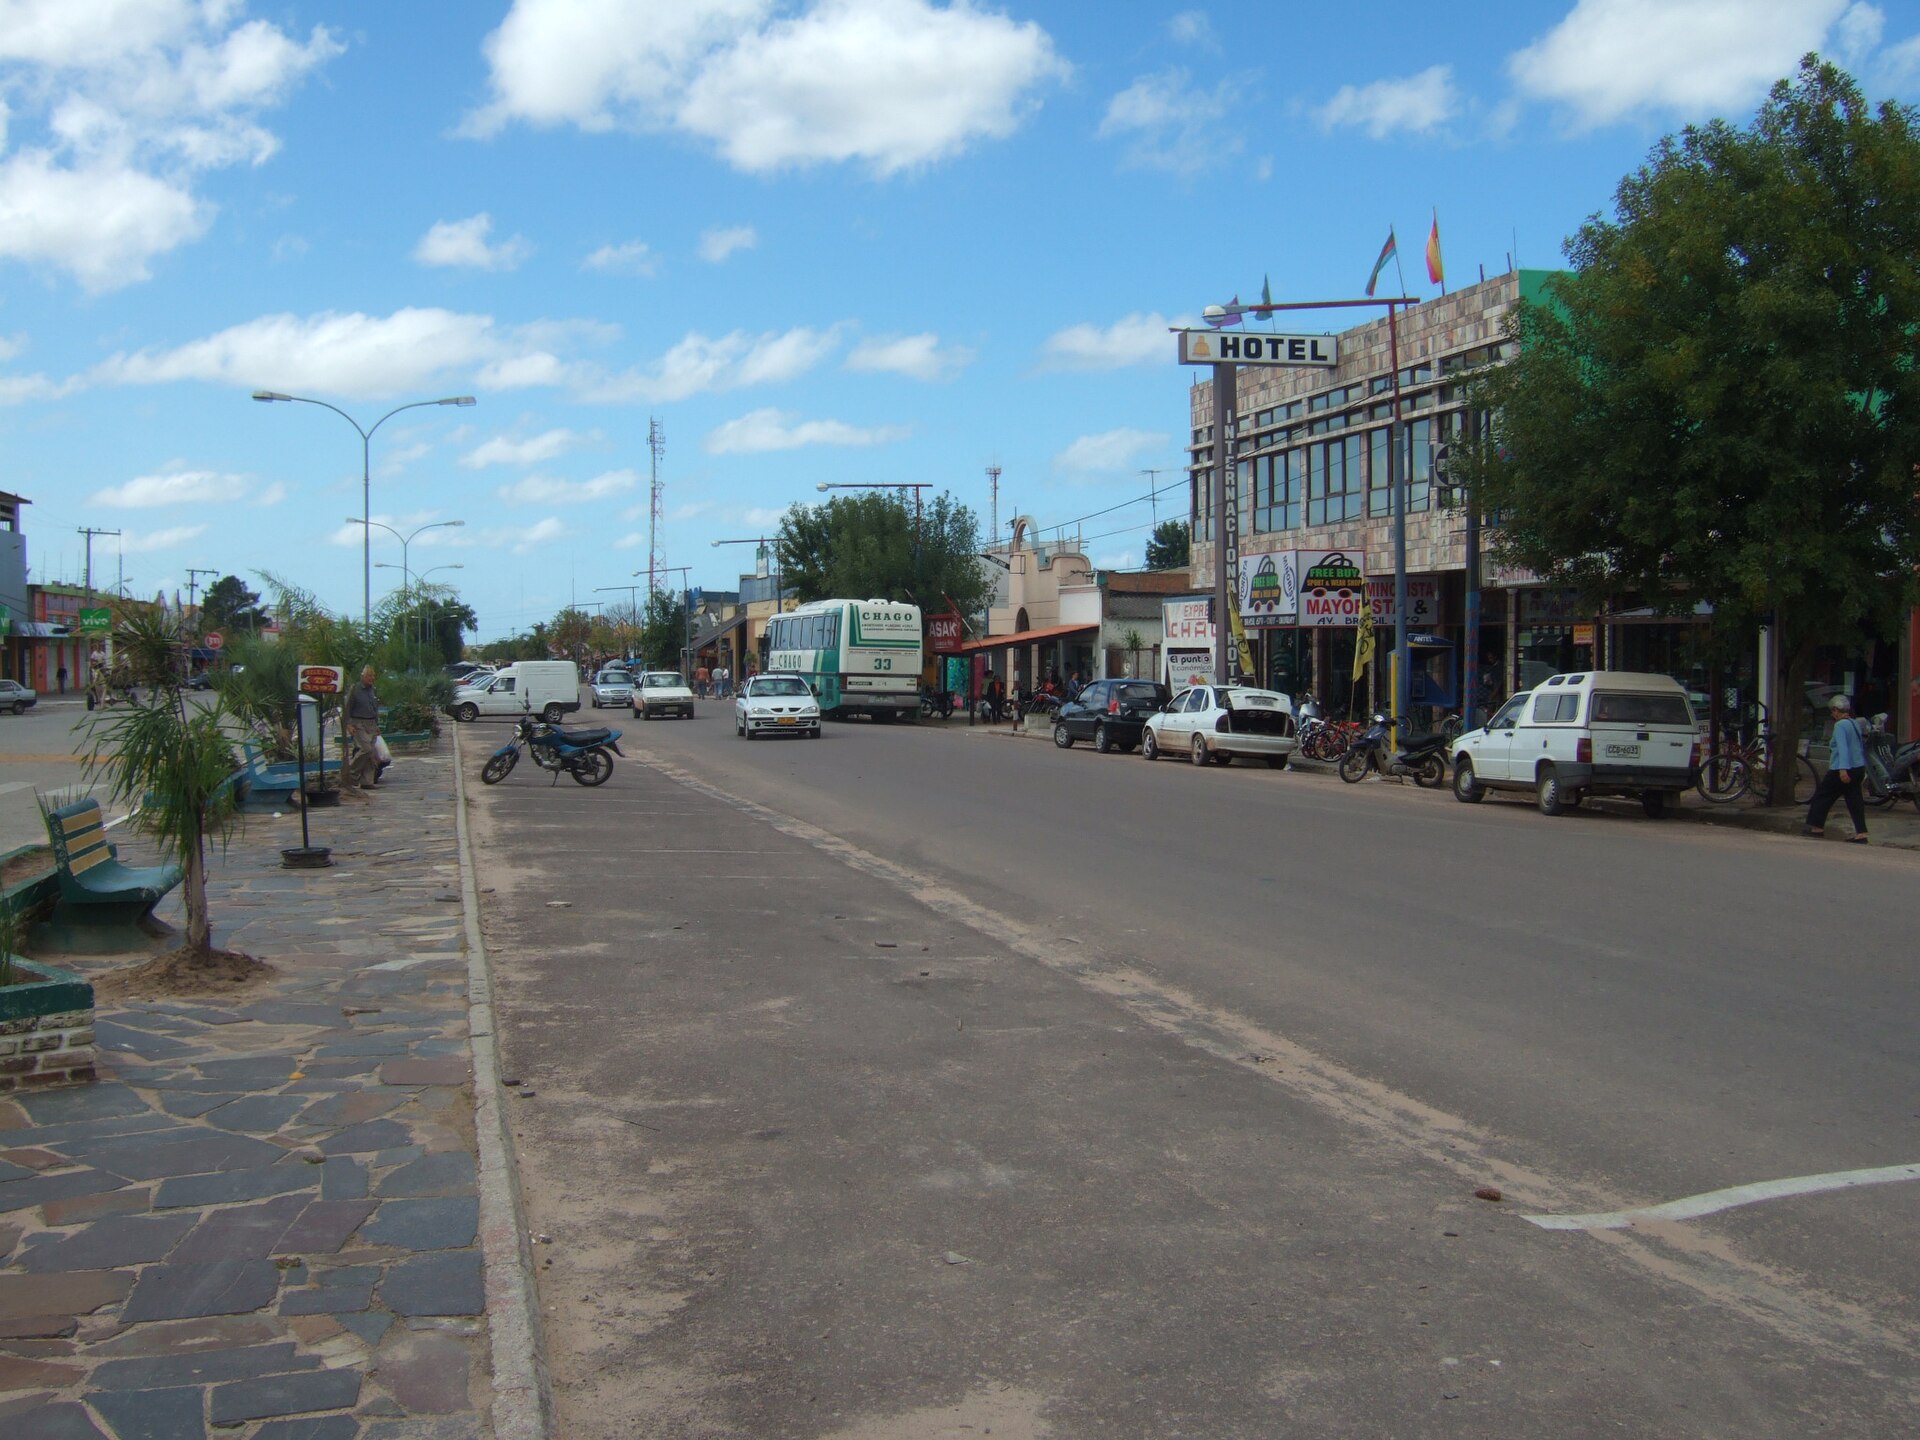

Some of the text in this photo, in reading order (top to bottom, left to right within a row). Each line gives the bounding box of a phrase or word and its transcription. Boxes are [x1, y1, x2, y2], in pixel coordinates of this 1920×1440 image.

[1220, 336, 1328, 361] HOTEL
[1310, 568, 1359, 578] FREE BUY
[1253, 576, 1265, 588] FREE
[1366, 582, 1434, 598] MINOISTA
[1306, 598, 1428, 615] MAYOST &
[82, 615, 109, 625] vivo
[862, 612, 912, 621] CHAGO
[1317, 616, 1335, 624] AV.
[1345, 616, 1388, 624] BRSIL
[779, 654, 802, 668] CHAGO
[874, 658, 892, 670] 33
[1170, 655, 1178, 663] El
